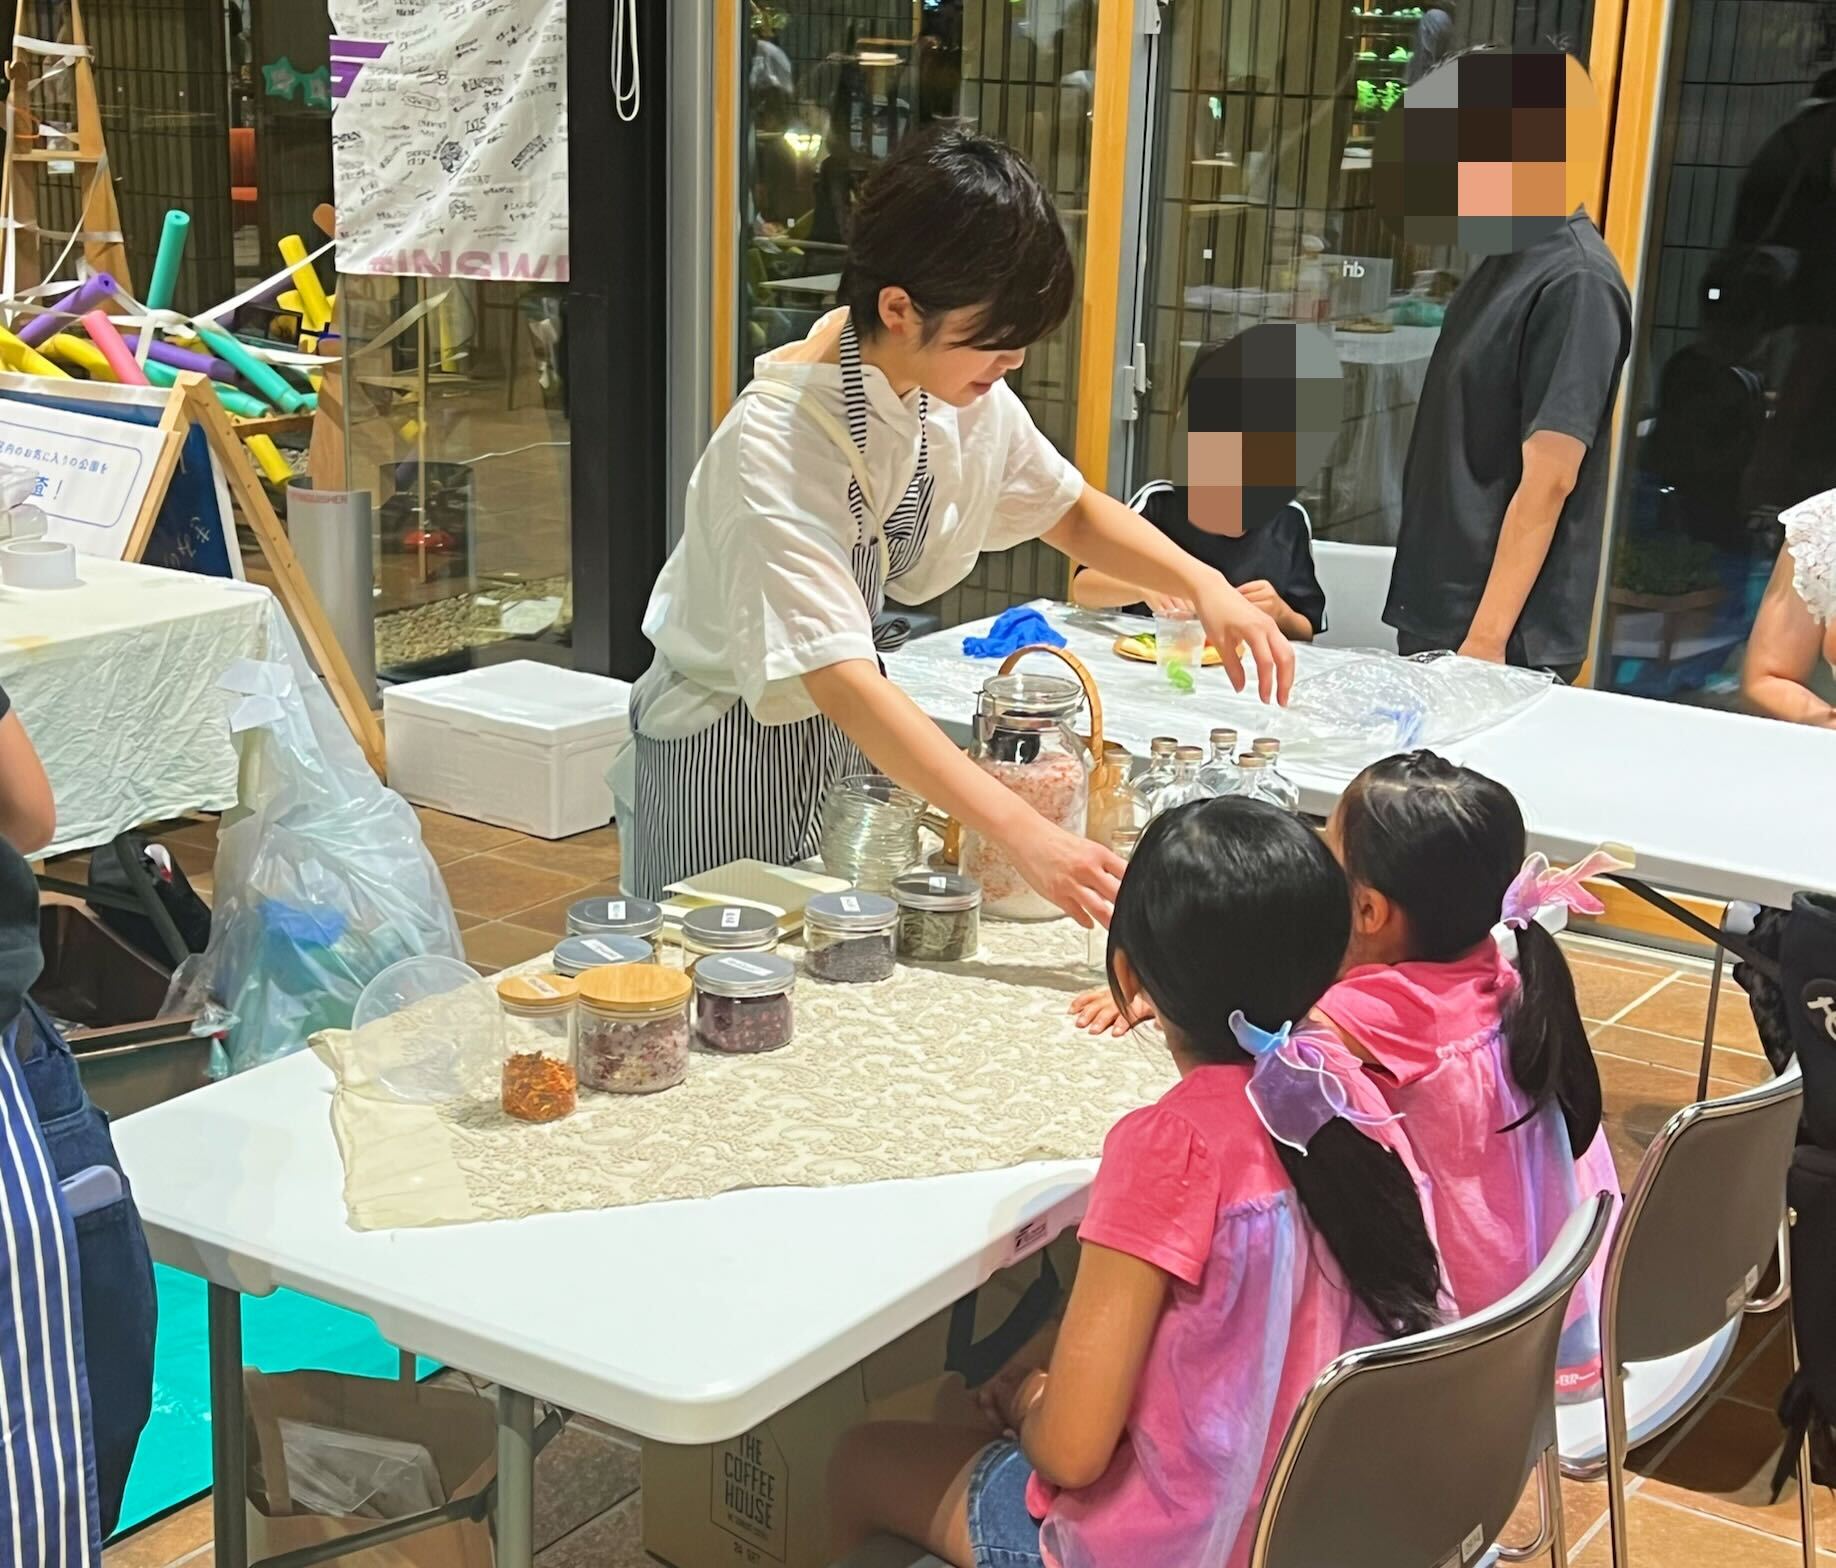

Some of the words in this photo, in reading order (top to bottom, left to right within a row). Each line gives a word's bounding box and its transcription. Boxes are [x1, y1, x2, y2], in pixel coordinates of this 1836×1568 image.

[740, 1434, 763, 1466] THE
[724, 1452, 775, 1502] COFFEE
[725, 1479, 773, 1530] HOUSE
